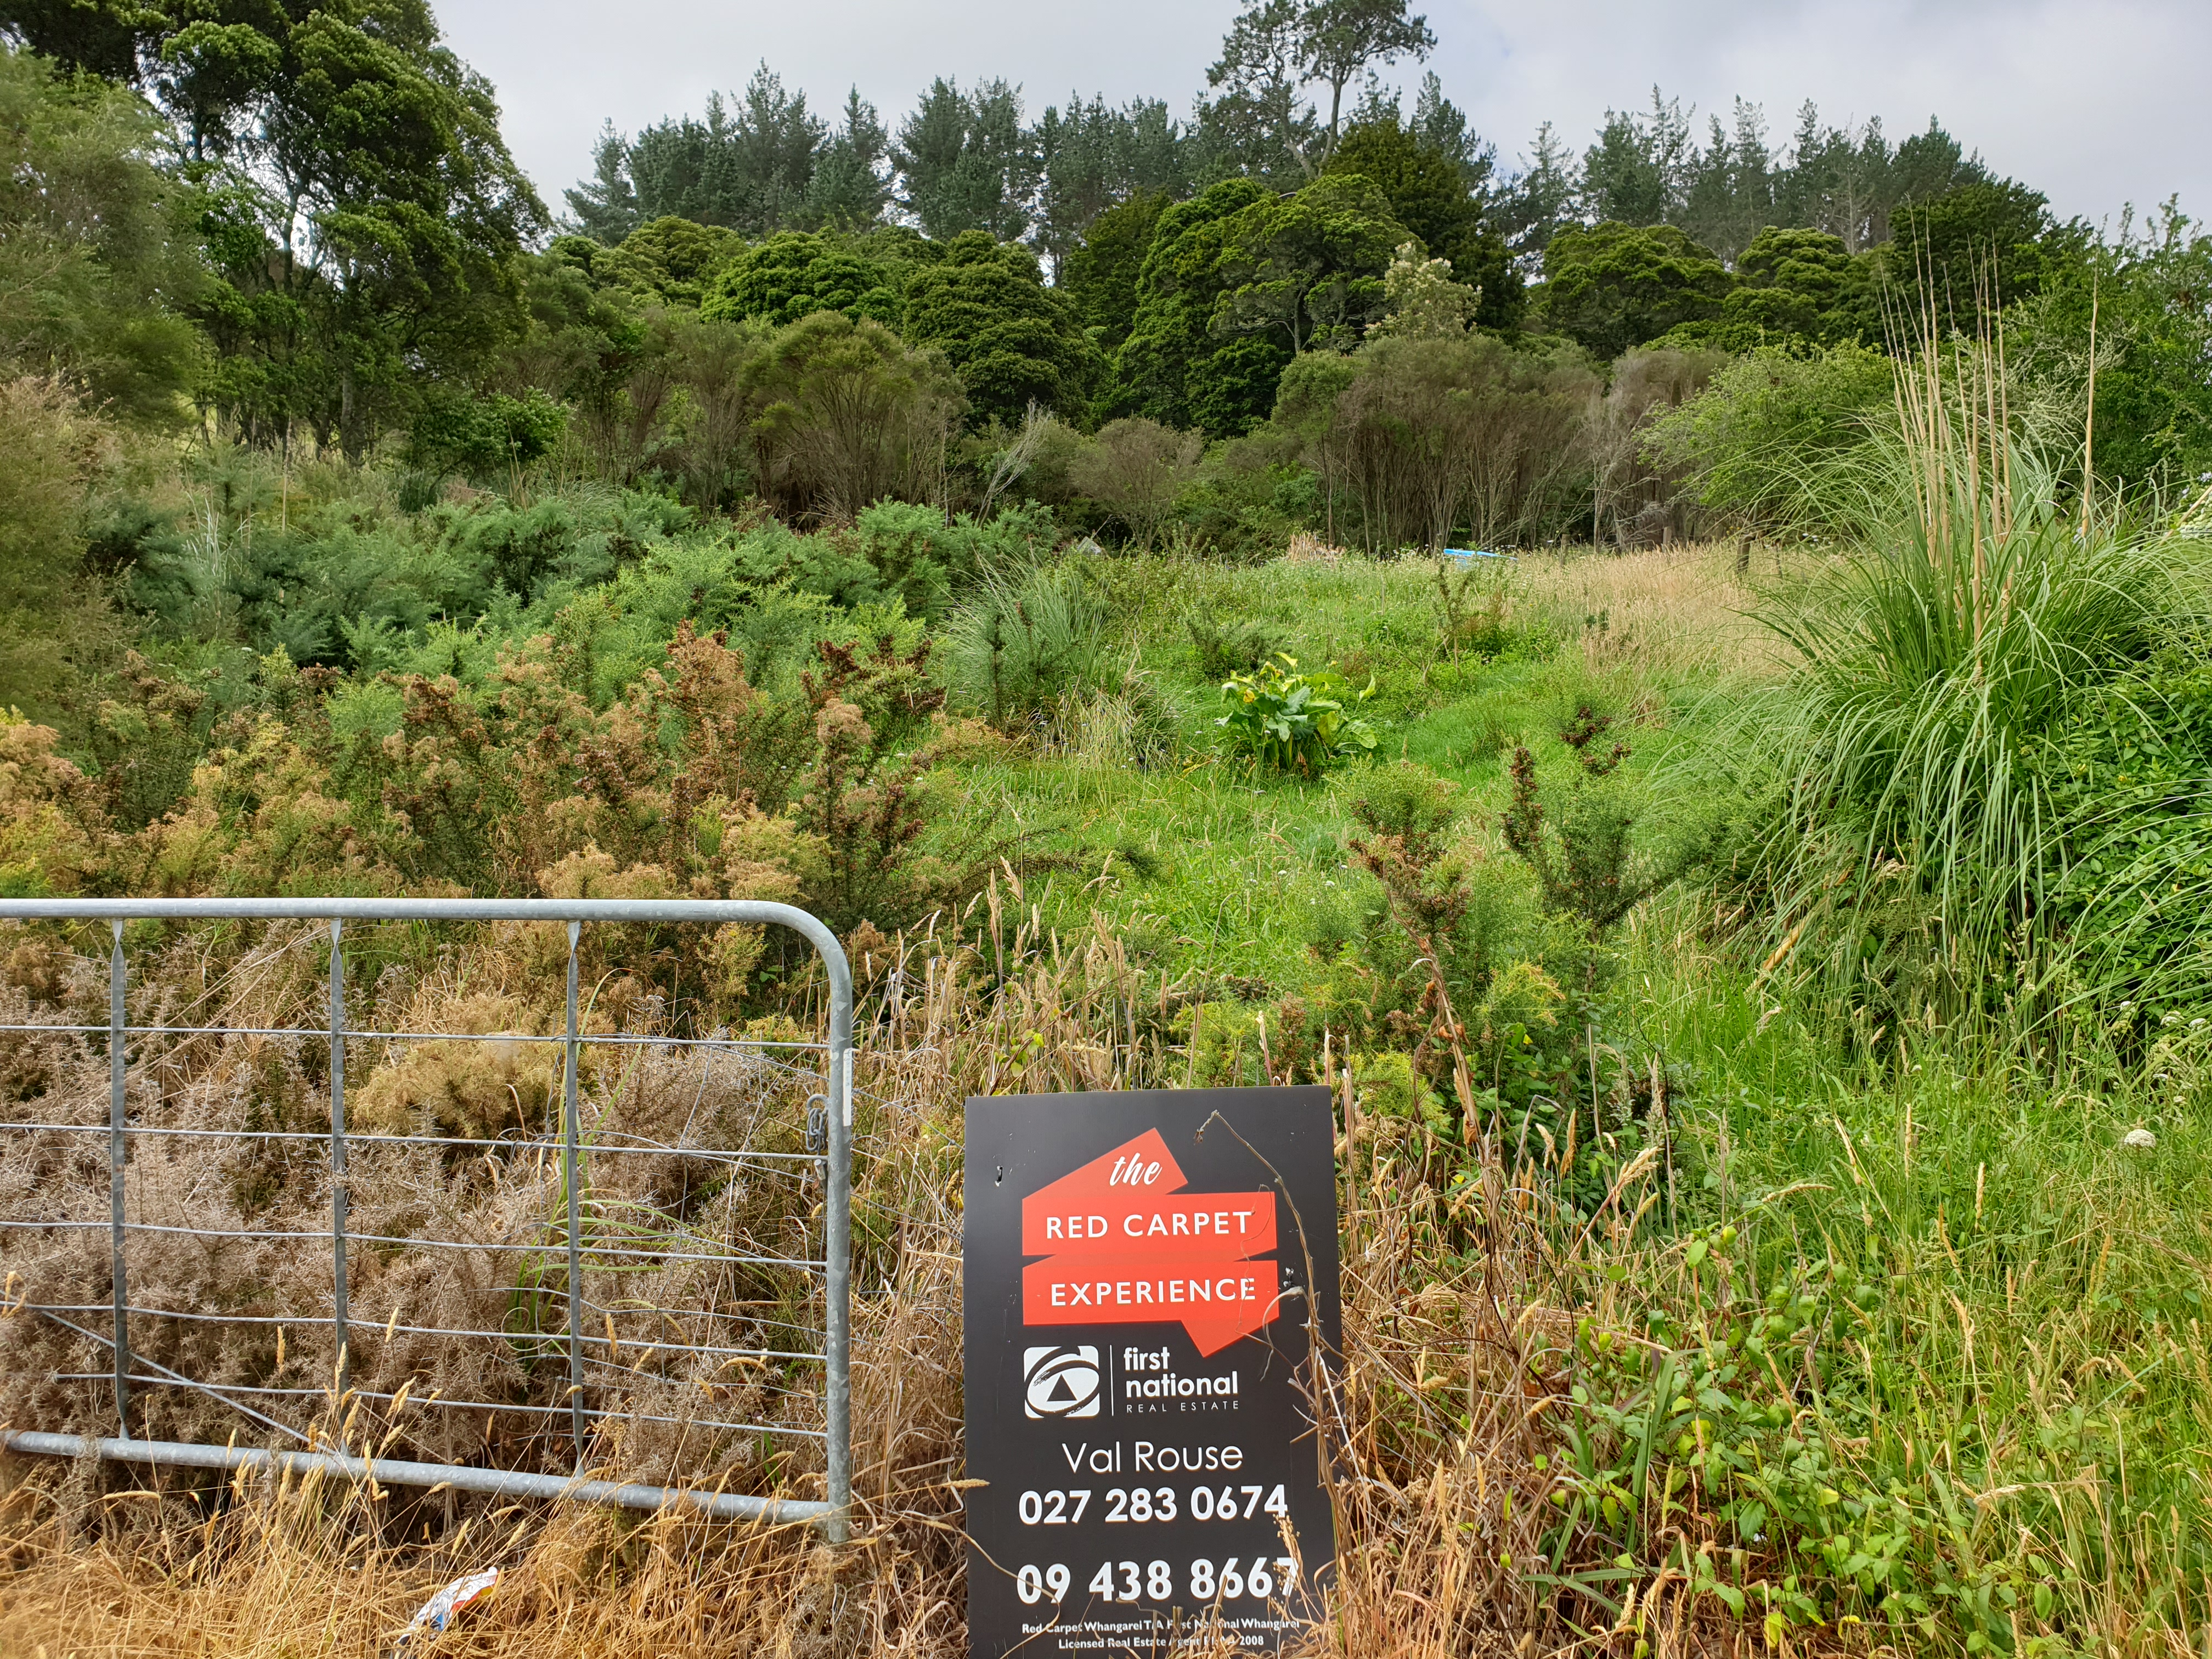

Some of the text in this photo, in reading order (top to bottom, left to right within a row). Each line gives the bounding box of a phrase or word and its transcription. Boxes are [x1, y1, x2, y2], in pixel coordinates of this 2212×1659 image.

[1109, 1152, 1163, 1186] the
[1046, 1211, 1251, 1239] RED CARPET
[1051, 1278, 1256, 1306] EXPERIENCE
[1124, 1346, 1170, 1371] first
[1126, 1370, 1238, 1398] national
[1126, 1400, 1238, 1413] REAL ESTATE
[1062, 1441, 1243, 1472] Val Rouse
[1019, 1484, 1288, 1525] 027 283 0674
[1017, 1557, 1299, 1604] 09 438 8667
[1022, 1623, 1042, 1634] Red
[1046, 1622, 1083, 1635] Carpet
[1084, 1620, 1142, 1633] Whangarei
[1166, 1619, 1192, 1630] Fst
[1058, 1637, 1104, 1649] Licensed
[1133, 1636, 1166, 1647] Estate
[1240, 1635, 1264, 1646] 2008
